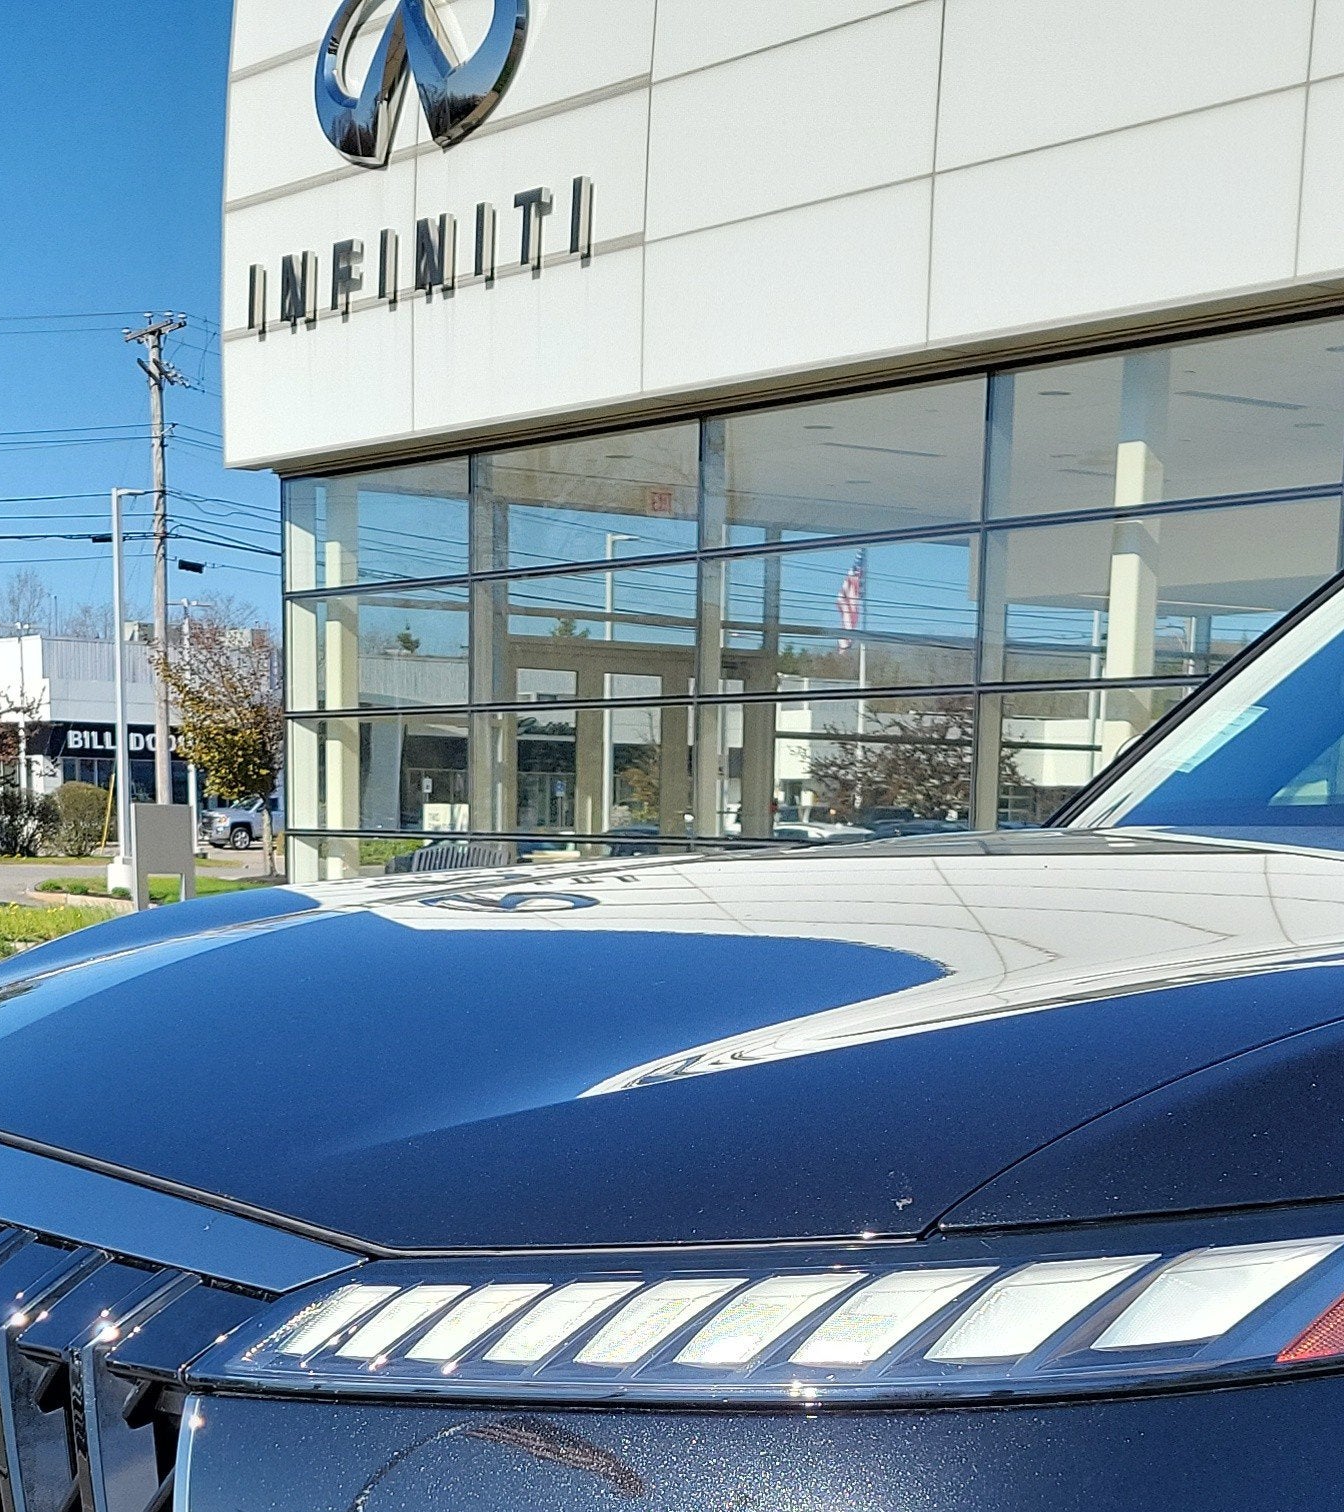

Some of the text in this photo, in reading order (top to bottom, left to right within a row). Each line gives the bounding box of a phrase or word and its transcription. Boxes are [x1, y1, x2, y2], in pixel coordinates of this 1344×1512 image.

[247, 176, 594, 335] INFINITI
[67, 730, 195, 752] BILL DOD
